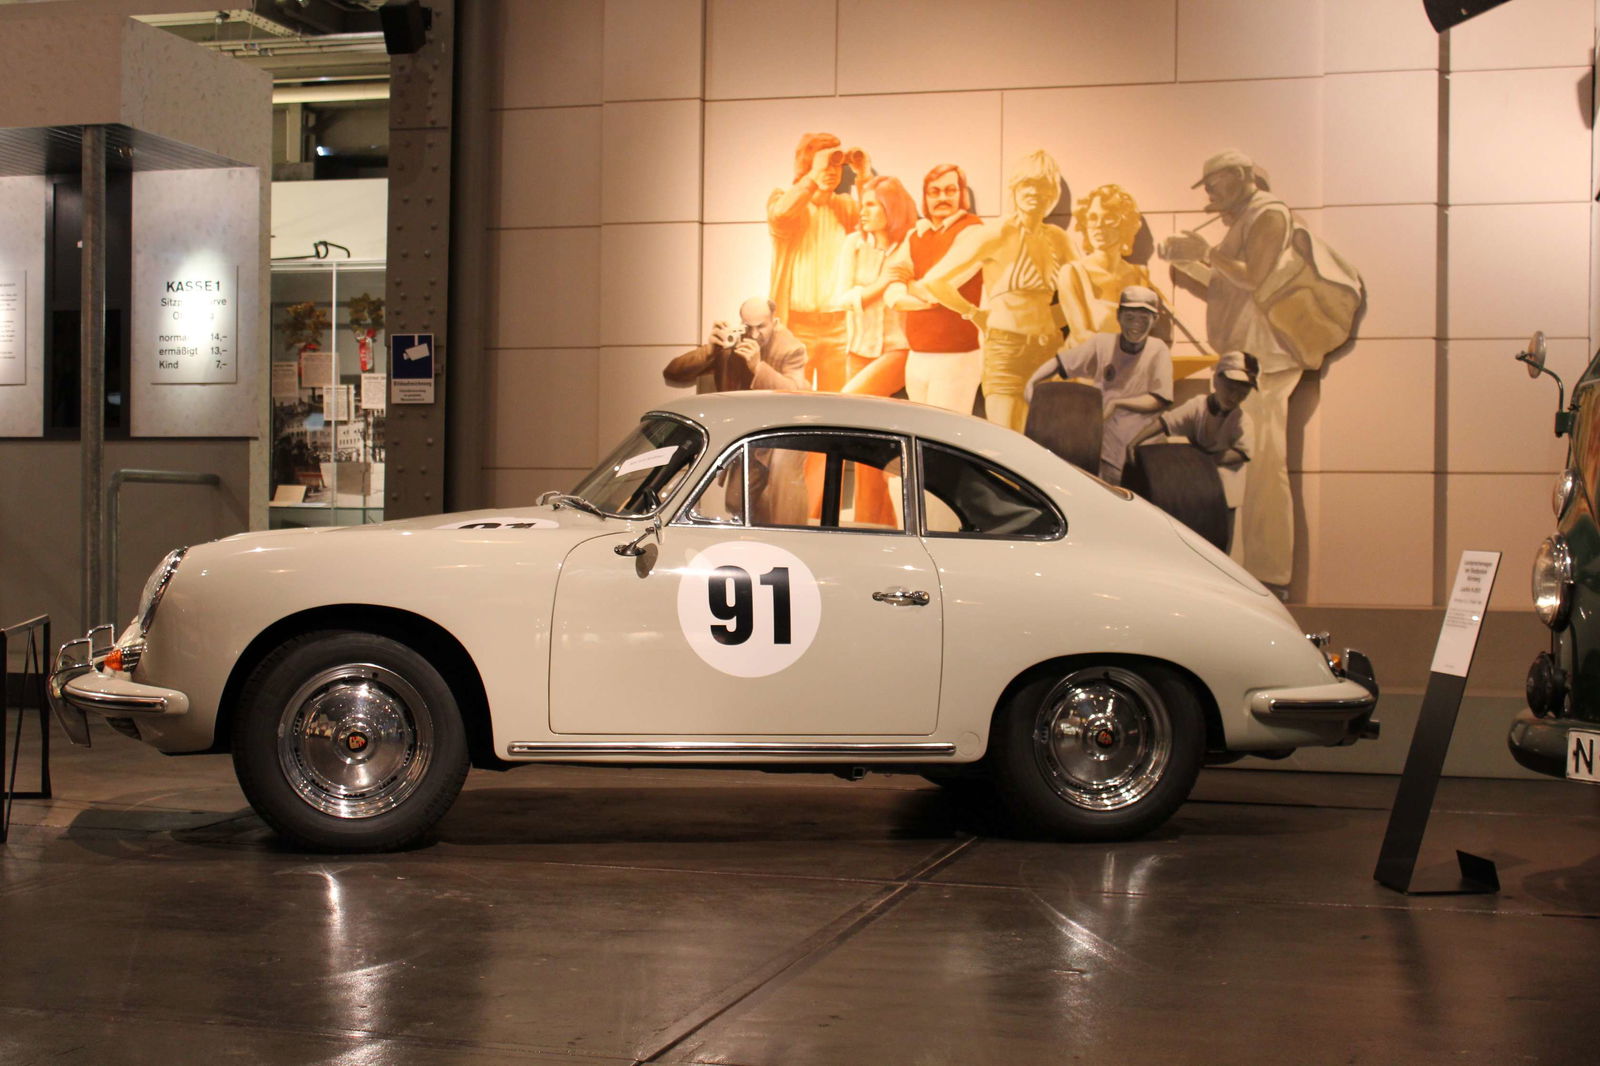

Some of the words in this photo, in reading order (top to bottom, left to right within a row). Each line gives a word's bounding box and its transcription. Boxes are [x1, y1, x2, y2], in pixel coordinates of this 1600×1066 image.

[159, 334, 189, 342] norma
[159, 346, 198, 357] ermäßigt
[159, 360, 179, 369] Kind
[708, 565, 791, 646] 91
[1575, 738, 1593, 775] N
